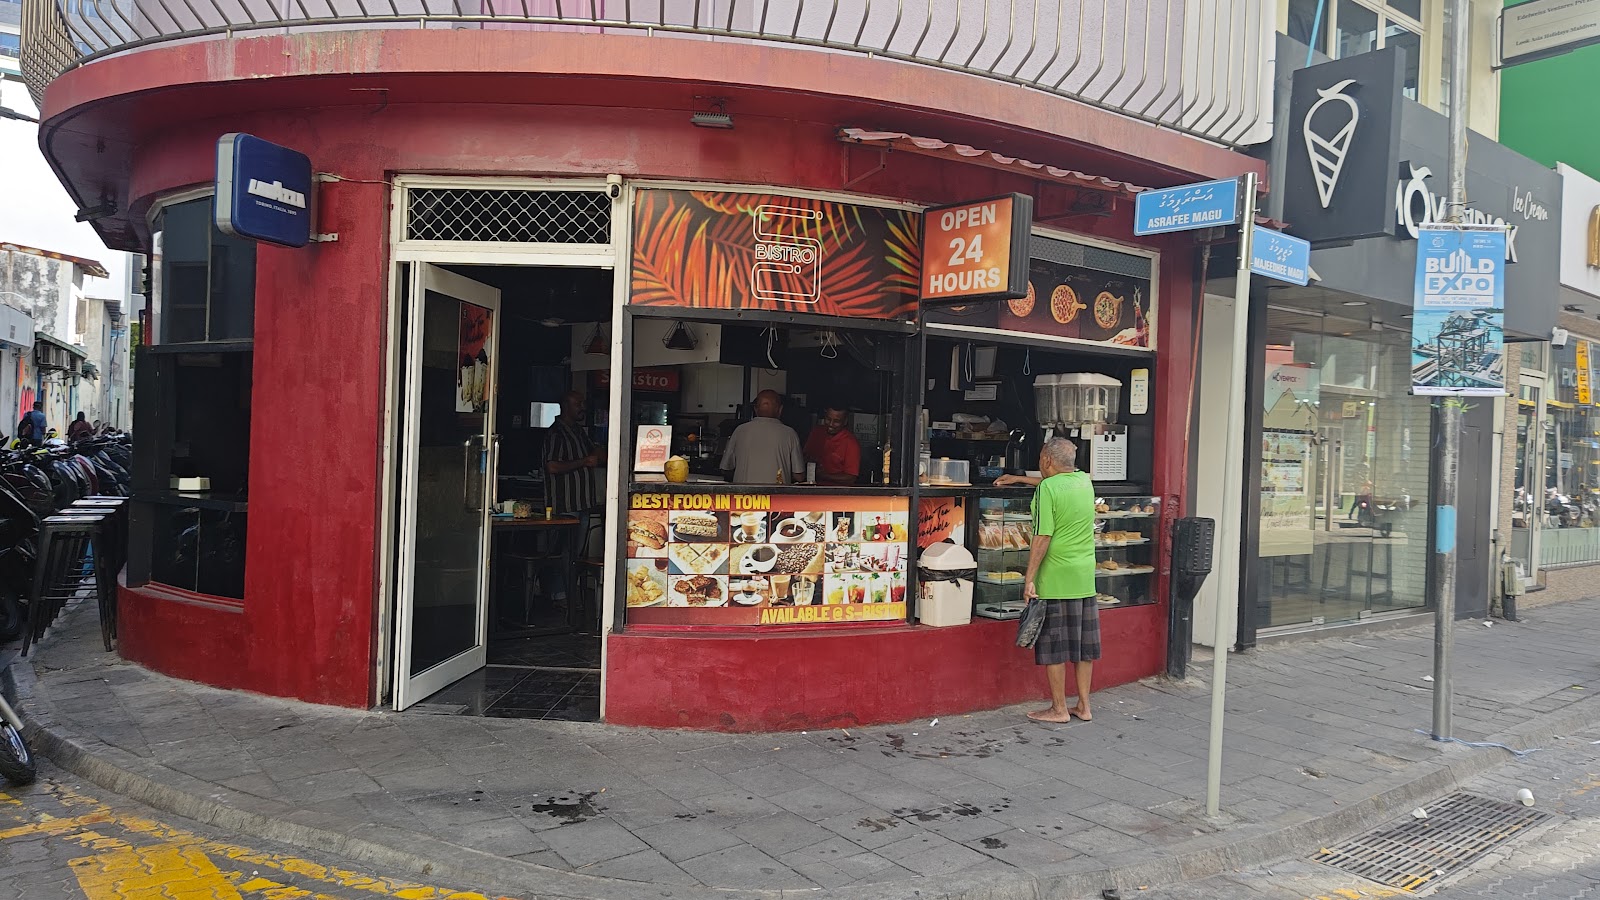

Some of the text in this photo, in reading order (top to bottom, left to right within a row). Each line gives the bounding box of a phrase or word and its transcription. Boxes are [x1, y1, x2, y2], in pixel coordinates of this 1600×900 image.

[1513, 186, 1524, 213] Ice
[1524, 191, 1548, 220] Cream
[941, 203, 996, 232] OPEN
[1147, 209, 1222, 229] ASRAFEE MAGU
[755, 243, 815, 264] BISTRO
[948, 234, 983, 267] 24
[1425, 248, 1495, 274] BUILD
[1254, 256, 1304, 280] MAJEEDHEE MAGU
[930, 267, 1001, 294] HOURS
[1428, 274, 1490, 294] EXPO
[632, 493, 771, 510] BEST FOOD IN TOWN
[761, 603, 906, 624] AVAILABLE @ S-BISTRO
